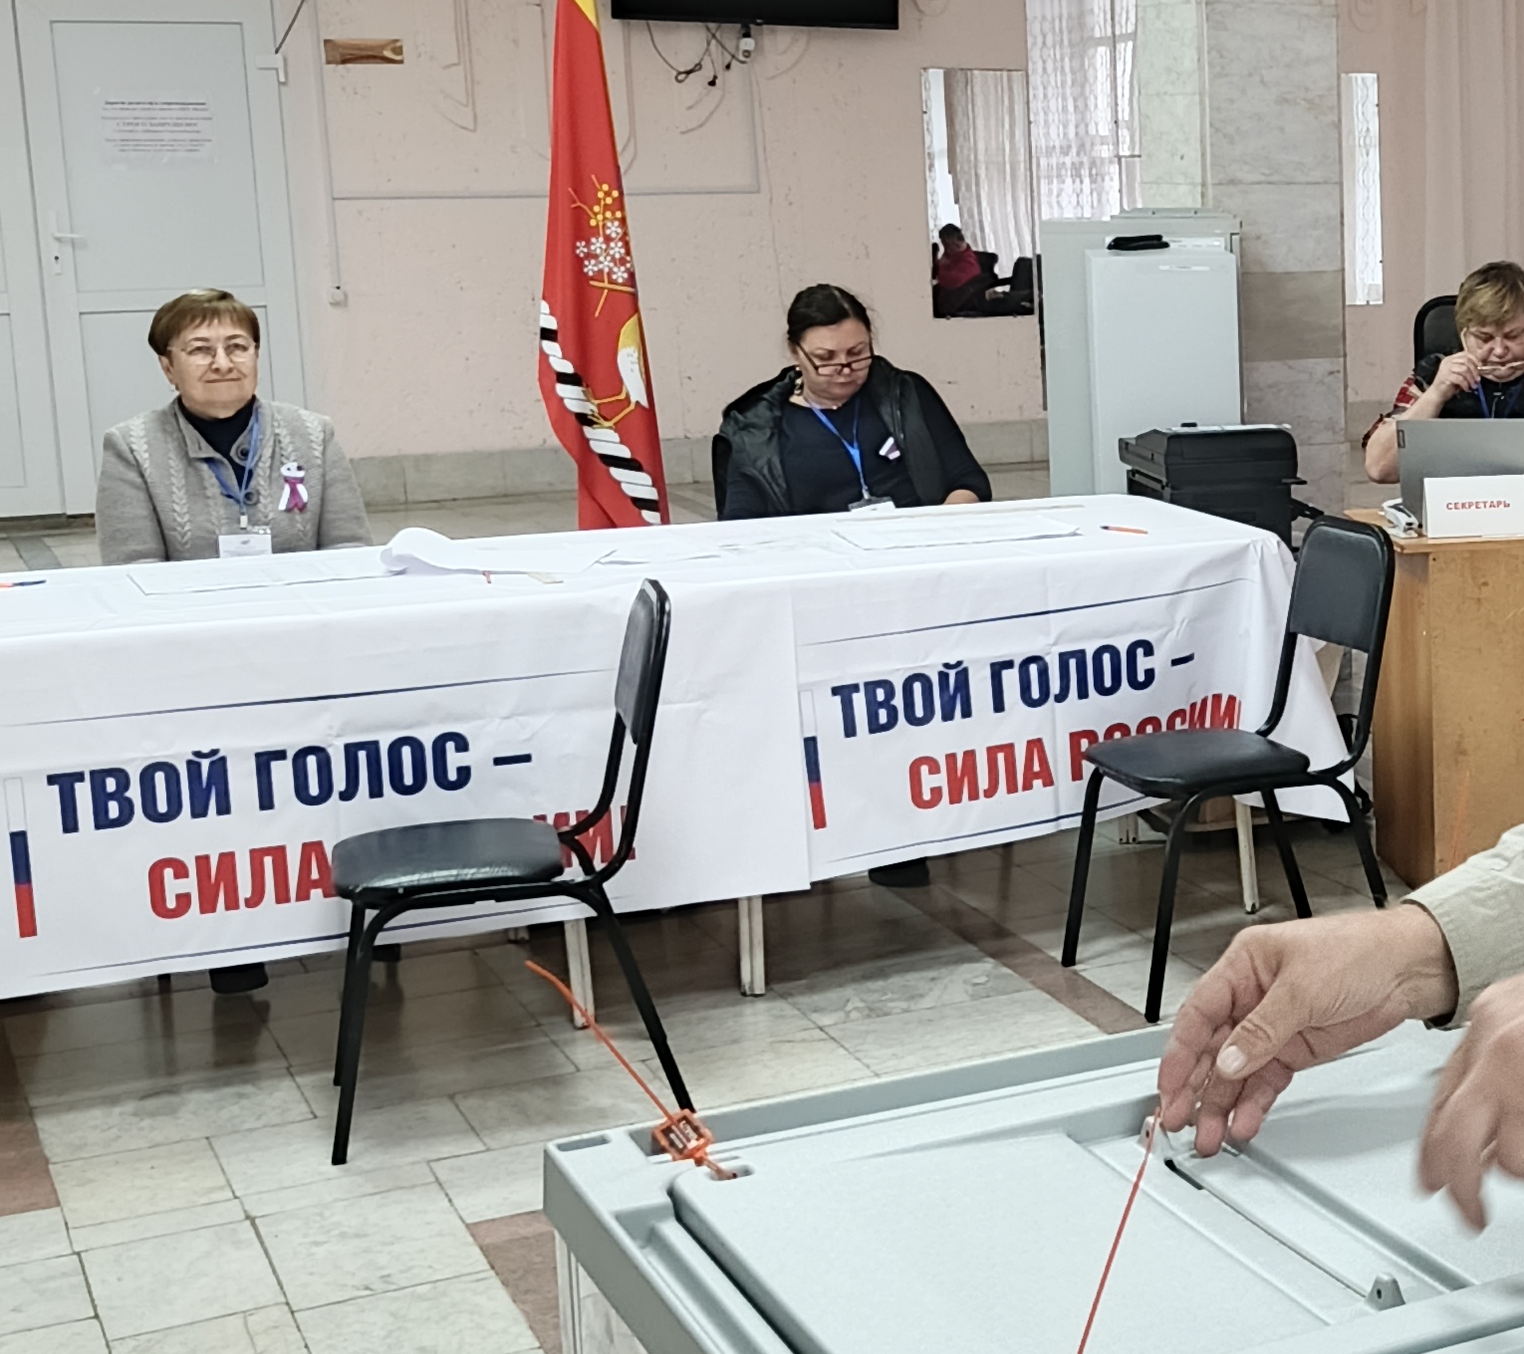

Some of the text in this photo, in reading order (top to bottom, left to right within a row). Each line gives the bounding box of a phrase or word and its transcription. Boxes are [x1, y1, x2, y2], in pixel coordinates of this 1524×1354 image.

[1445, 499, 1511, 511] СЕКРЕТАРЬ
[831, 661, 972, 739] ТВОЙ
[990, 639, 1156, 715] ГОЛОС
[47, 748, 232, 834] ТВОЙ
[256, 731, 472, 812] ГОЛОС
[909, 737, 1055, 810] СИЛА
[147, 839, 335, 920] СИЛА
